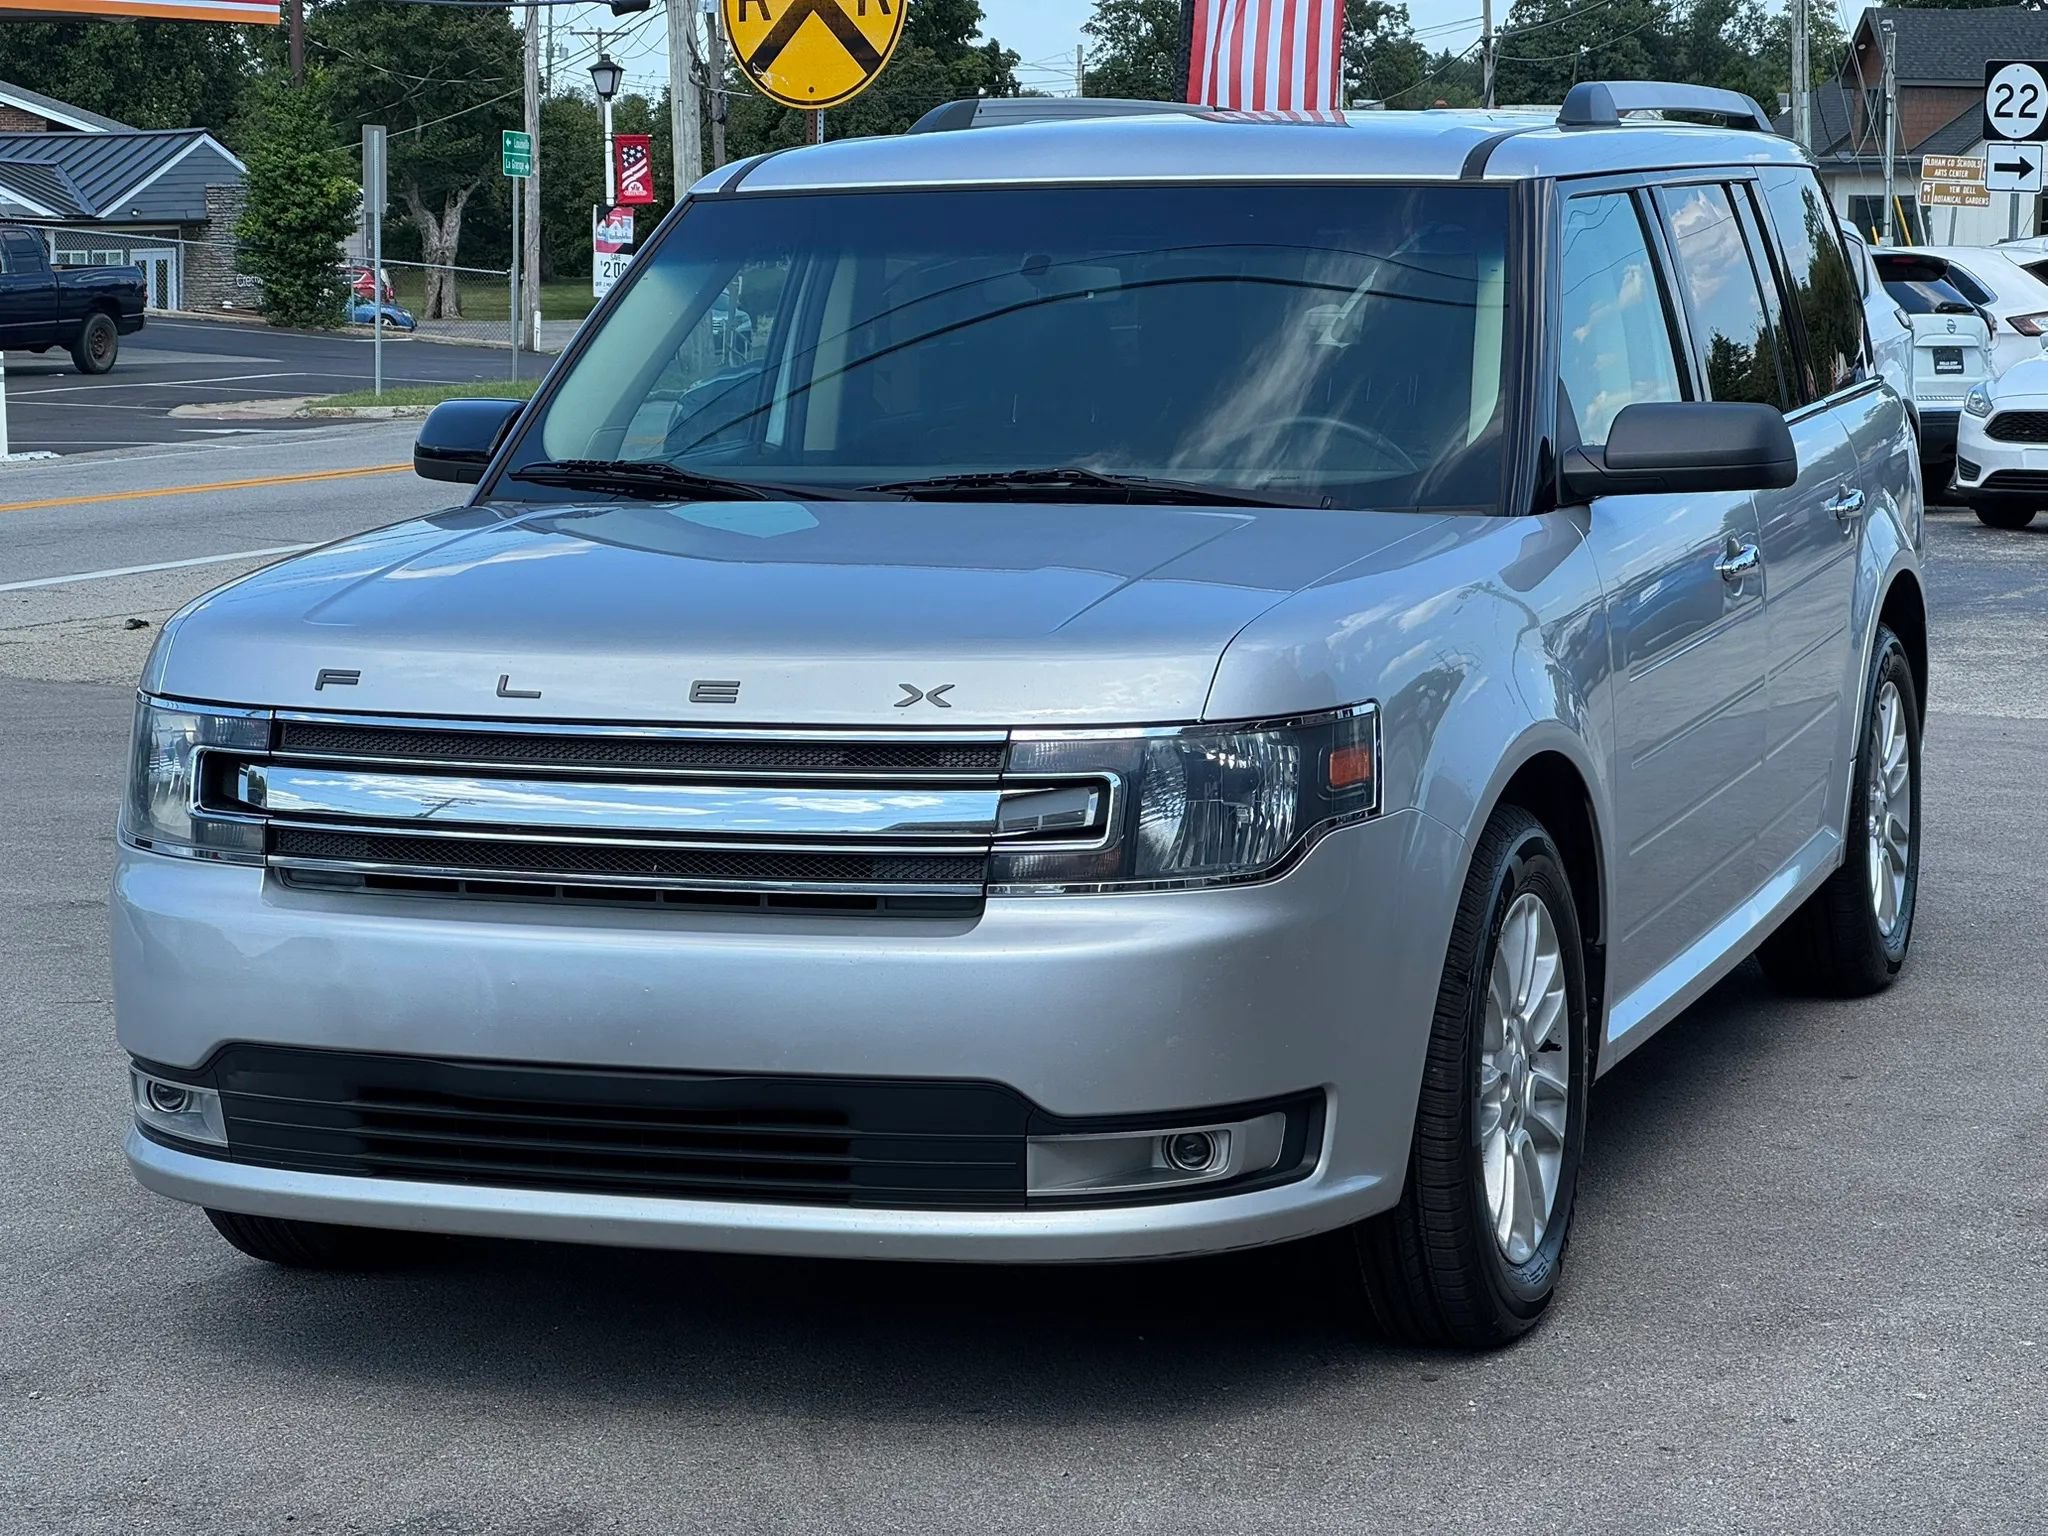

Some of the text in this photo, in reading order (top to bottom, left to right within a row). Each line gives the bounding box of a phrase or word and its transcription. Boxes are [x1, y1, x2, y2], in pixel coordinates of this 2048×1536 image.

[1994, 83, 2039, 119] 22
[1924, 157, 1982, 169] OLDHAM CO SCHOOLS
[1933, 168, 1969, 178] ARTS CENTER
[1949, 185, 1961, 194] YEW
[1933, 194, 1990, 206] BOTANICAL GARDENS
[610, 253, 622, 262] SAVE
[314, 667, 956, 709] FLEX
